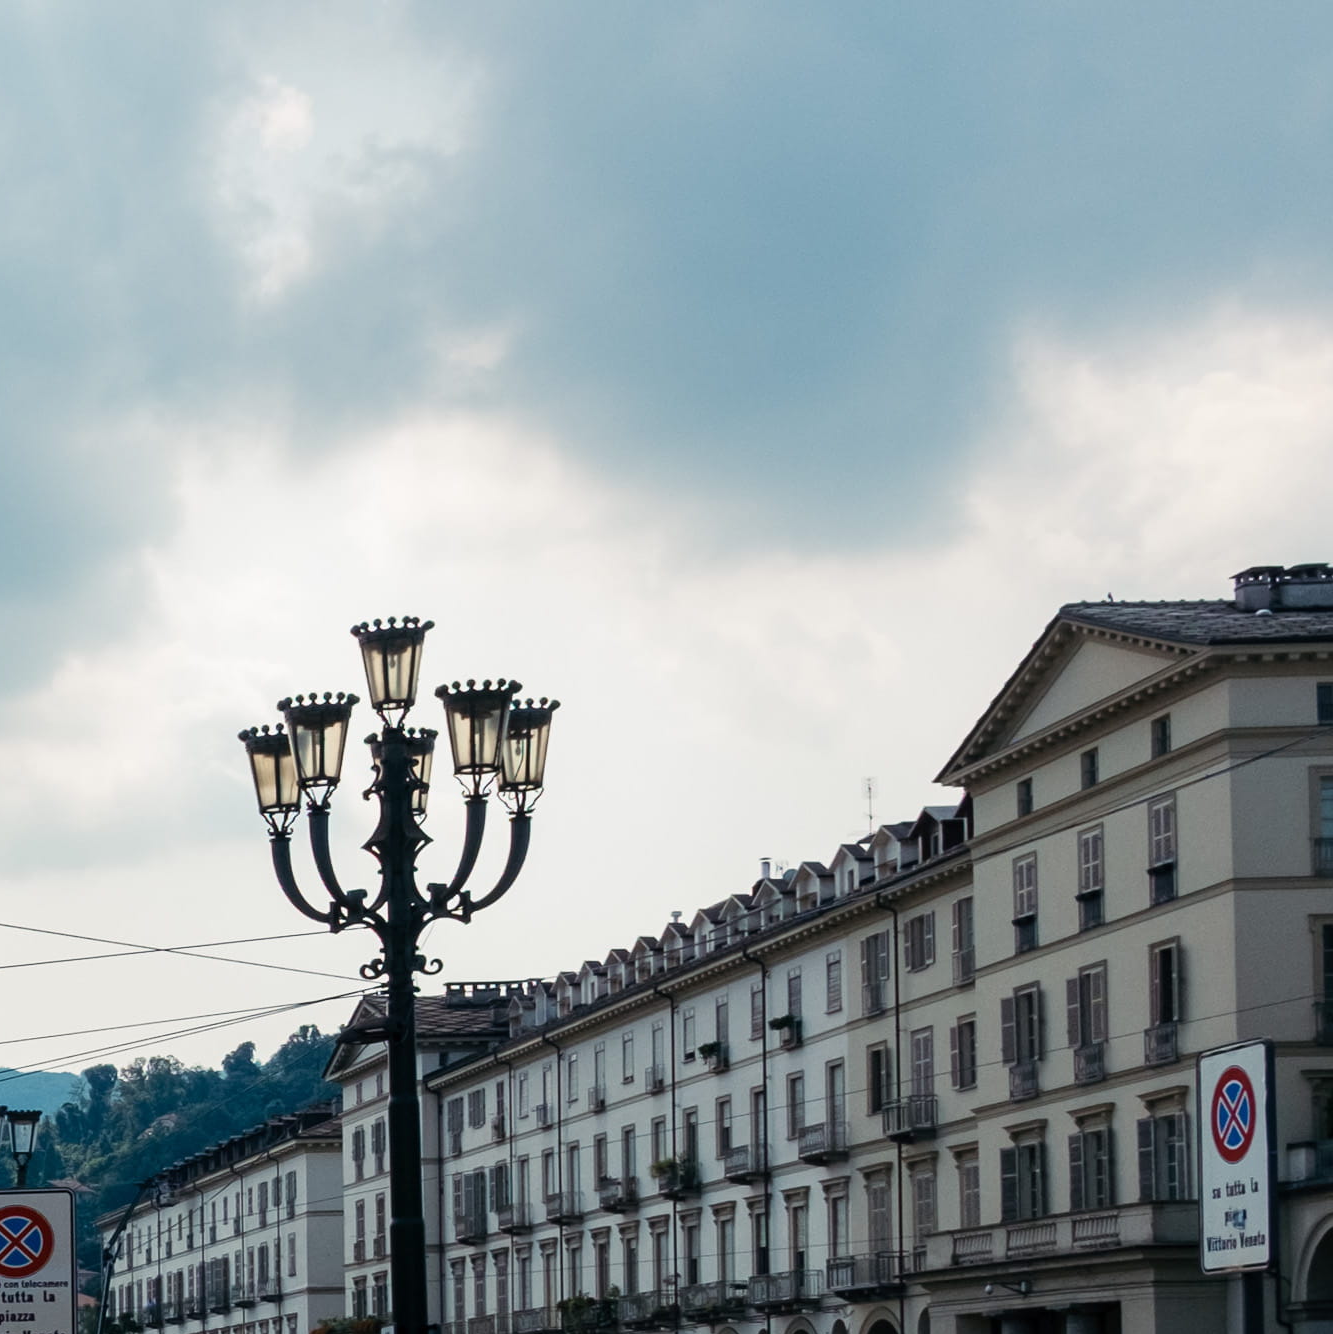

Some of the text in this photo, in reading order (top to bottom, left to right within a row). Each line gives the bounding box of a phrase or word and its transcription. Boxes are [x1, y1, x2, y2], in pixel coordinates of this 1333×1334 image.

[1212, 1188, 1221, 1199] su
[1250, 1177, 1259, 1193] la
[1206, 1230, 1265, 1252] Vittorio Veneto
[21, 1280, 68, 1288] telecamere
[1, 1291, 34, 1303] tutta
[43, 1290, 55, 1303] la
